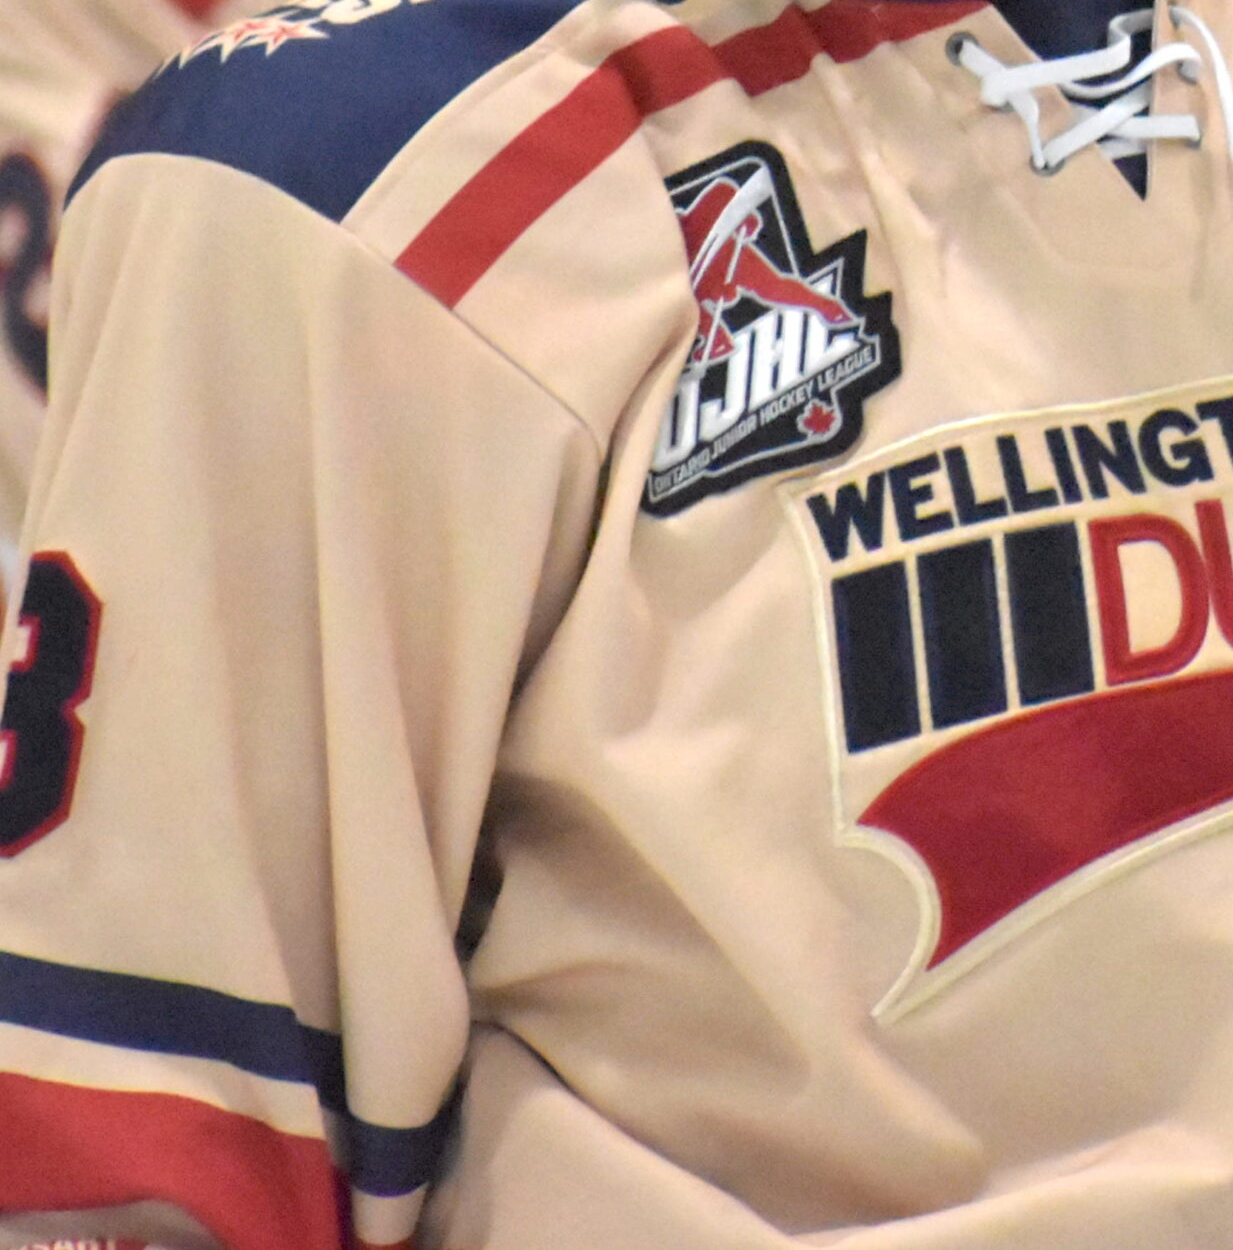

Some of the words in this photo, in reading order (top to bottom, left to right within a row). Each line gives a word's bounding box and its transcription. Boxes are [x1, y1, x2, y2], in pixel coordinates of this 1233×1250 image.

[710, 414, 759, 462] JUNIOR
[760, 380, 817, 427] HOCKEY
[816, 346, 874, 394] LEAGUE
